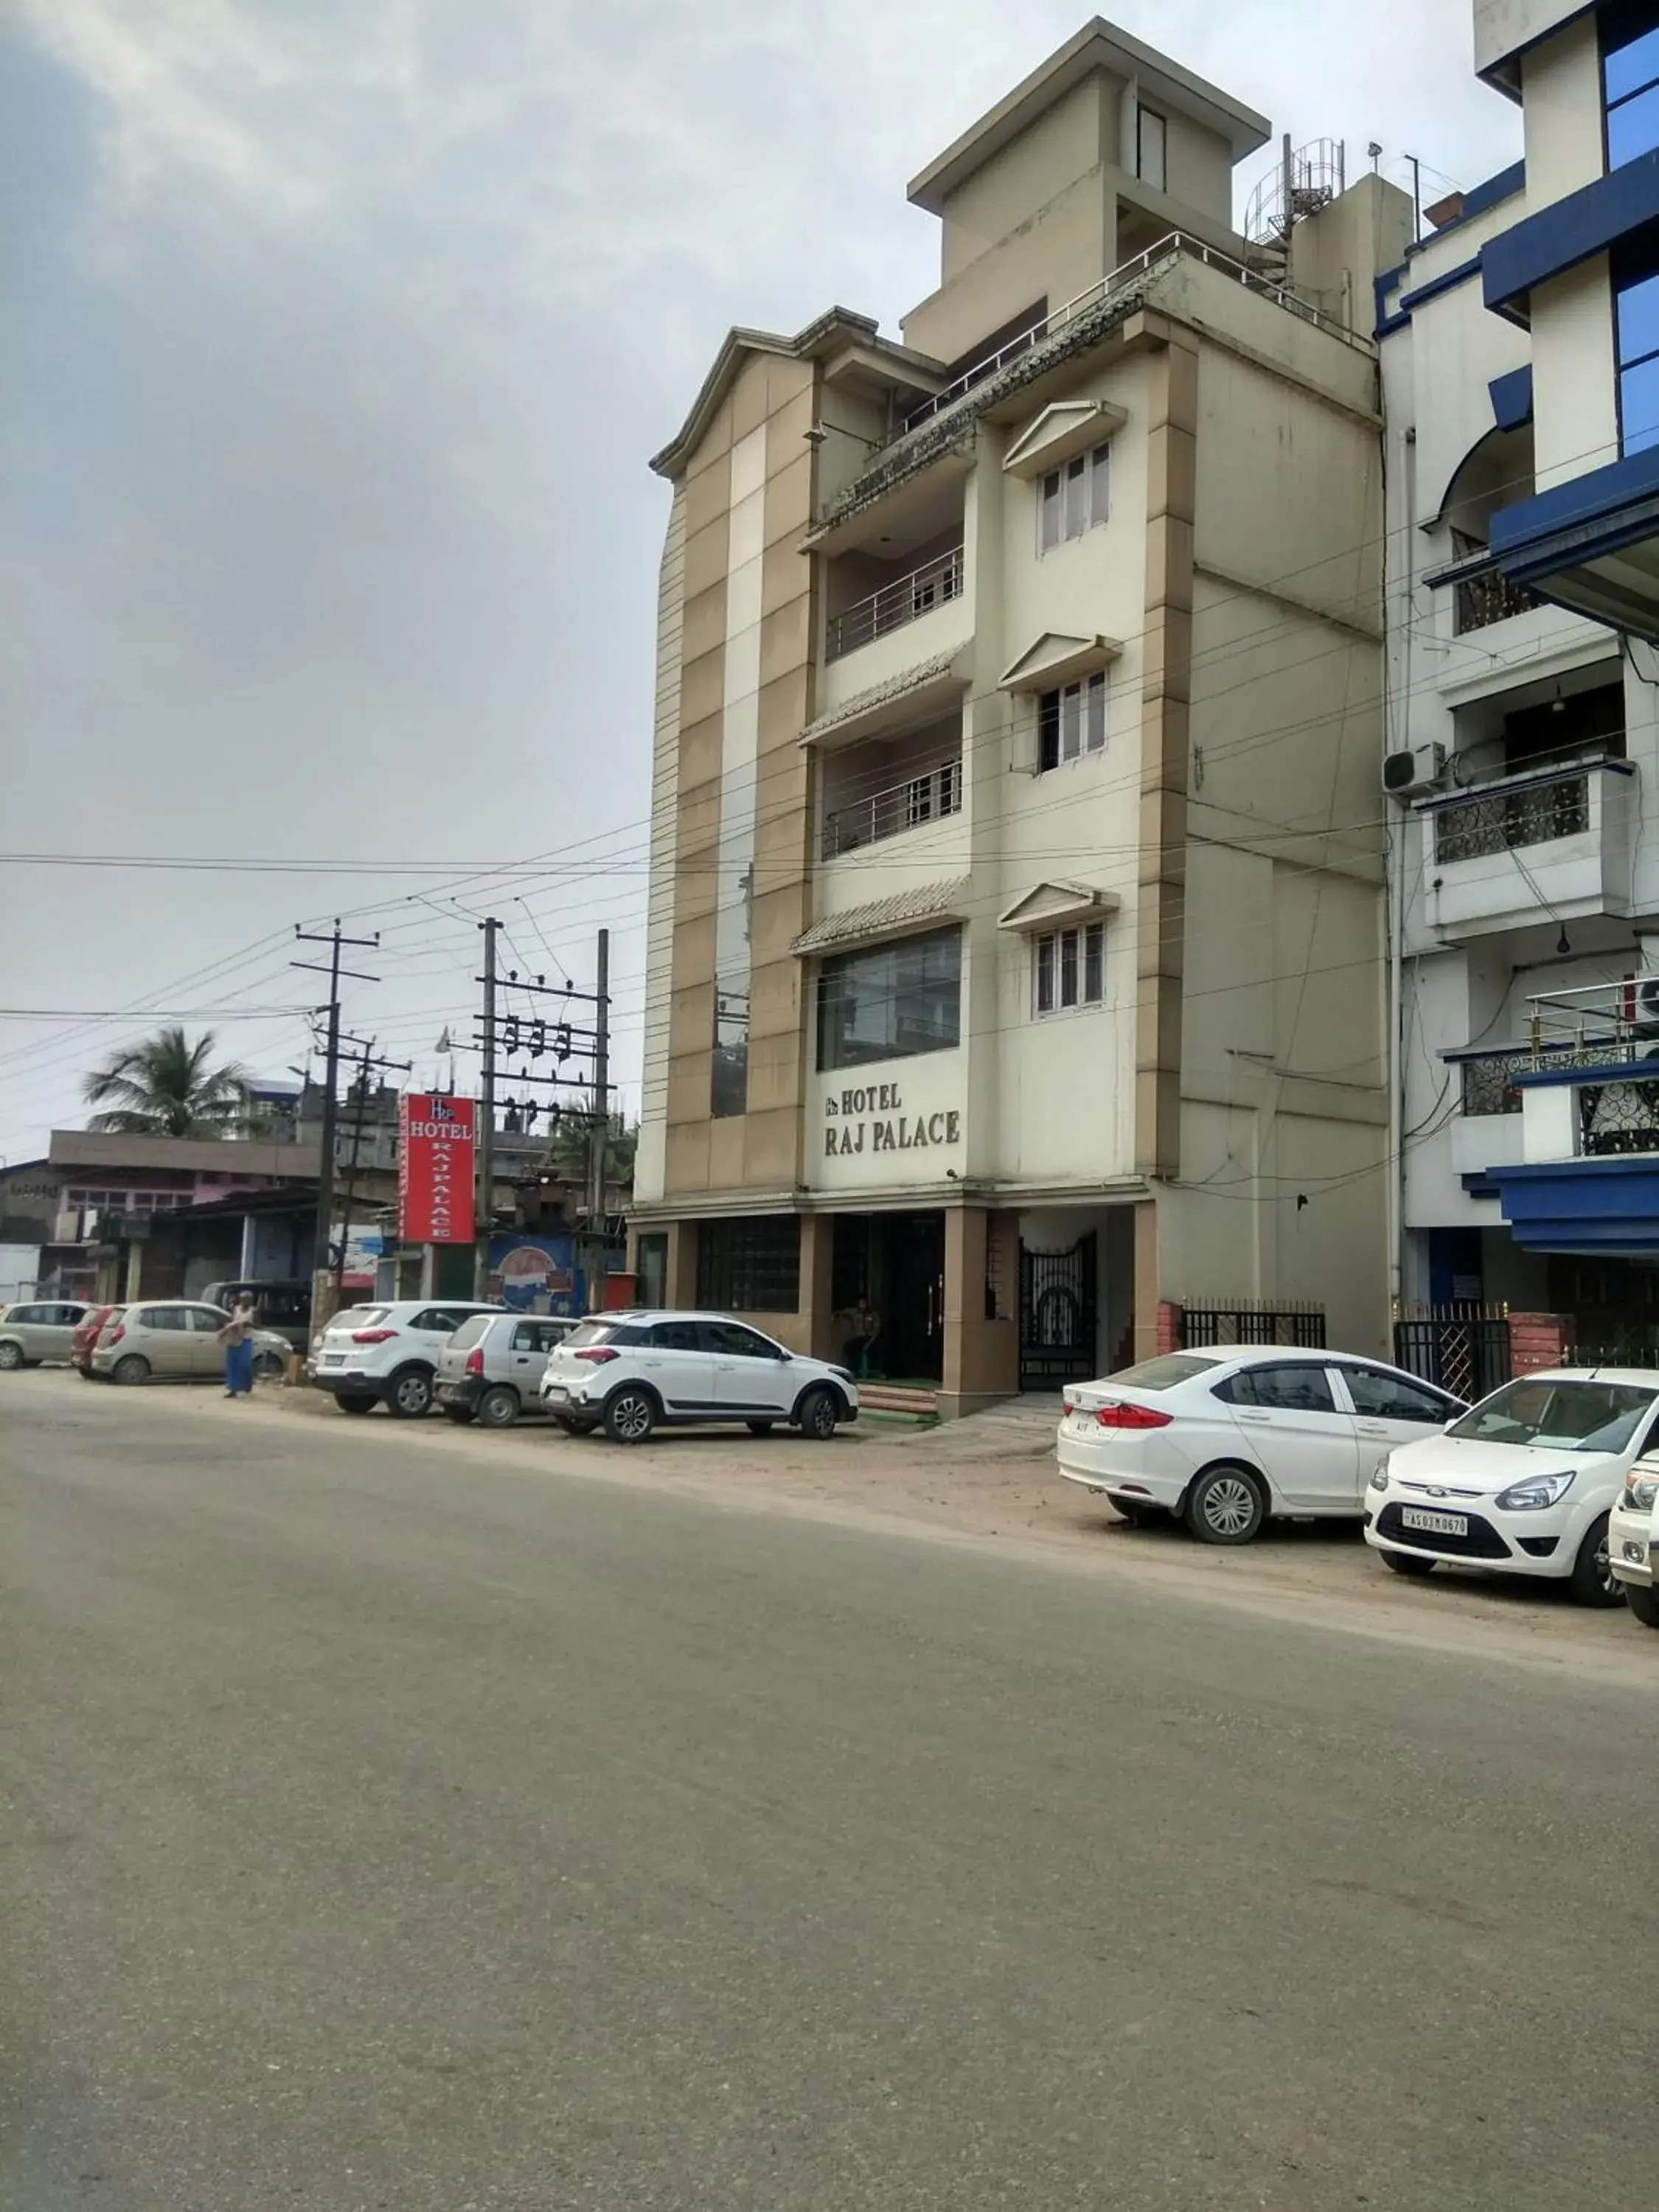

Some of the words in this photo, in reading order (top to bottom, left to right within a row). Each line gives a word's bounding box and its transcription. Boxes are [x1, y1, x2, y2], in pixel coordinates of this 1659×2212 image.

[841, 1082, 902, 1115] HOTEL
[410, 1121, 472, 1139] HOTEL
[825, 1123, 865, 1156] RAJ
[873, 1110, 959, 1151] PALACE
[431, 1142, 454, 1237] RAJPALACE
